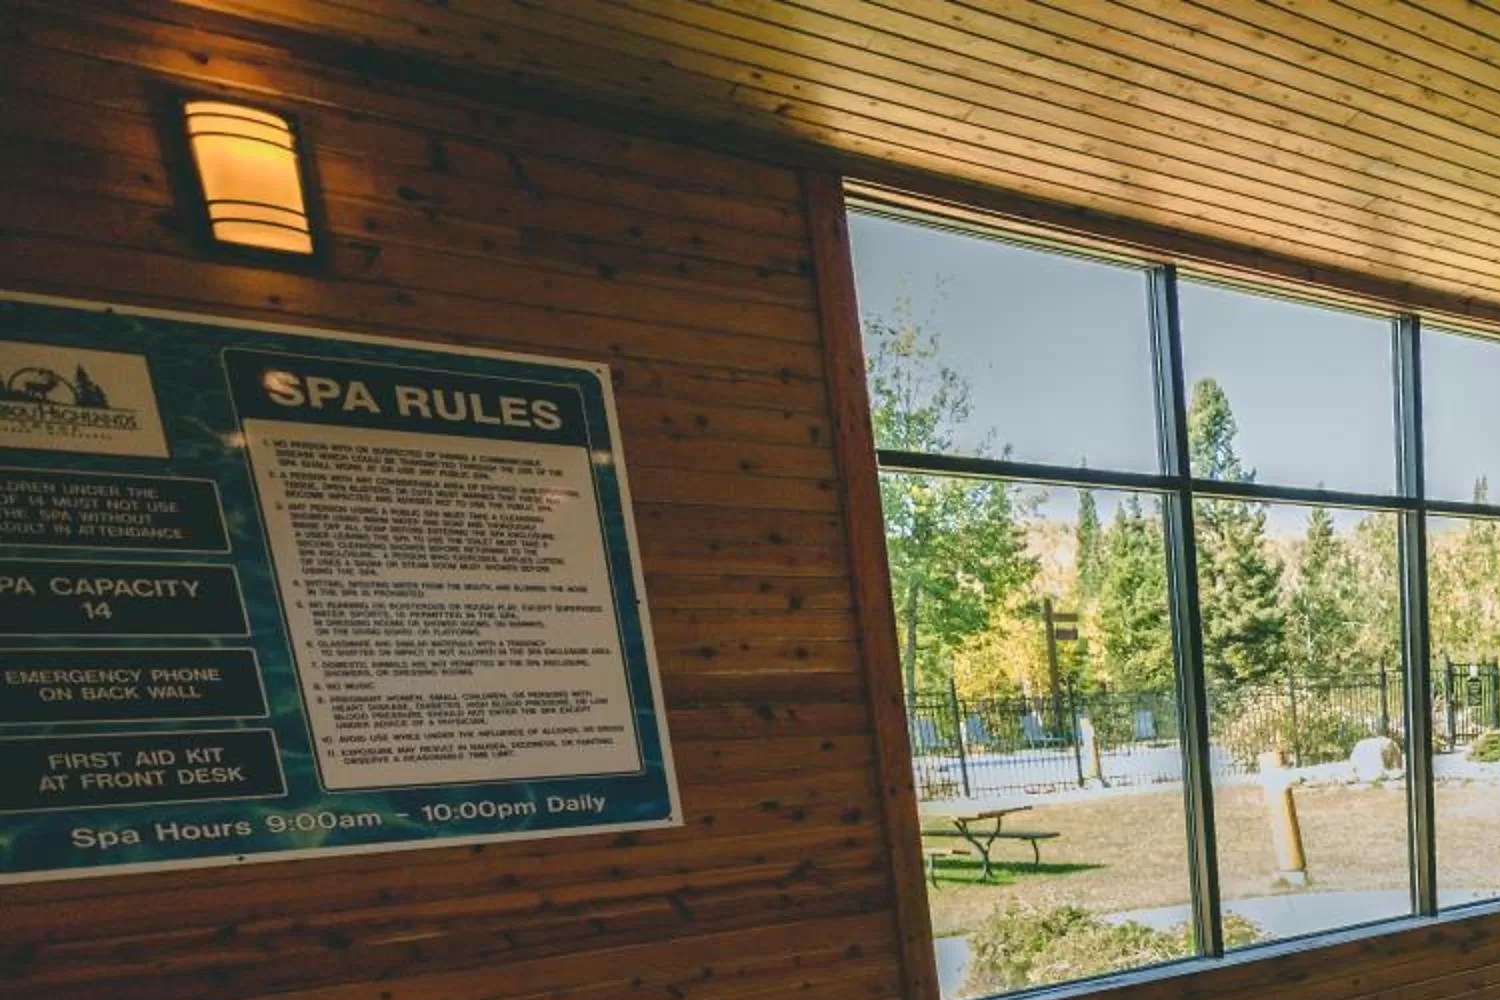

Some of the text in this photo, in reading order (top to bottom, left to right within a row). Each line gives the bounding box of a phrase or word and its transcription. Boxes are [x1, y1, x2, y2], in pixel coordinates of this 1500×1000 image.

[261, 371, 563, 430] SPA RULES
[62, 482, 119, 496] UNDER
[127, 486, 159, 499] THE
[51, 496, 99, 509] MUST
[106, 498, 138, 511] NOT
[147, 501, 180, 513] USE
[78, 510, 152, 524] WITHOUT
[79, 525, 183, 539] ATTENDANCE
[49, 576, 200, 598] CAPACITY
[81, 600, 112, 620] 14
[5, 668, 222, 685] EMERGENCY PHONE
[39, 685, 201, 701] ON BACK WALL
[48, 747, 224, 770] FIRST AID KIT
[39, 766, 247, 792] AT FRONT DESK
[71, 827, 141, 850] Spa
[154, 819, 252, 842] Hours
[265, 809, 382, 832] 9:00am
[422, 797, 537, 821] 10:00pm
[547, 793, 605, 813] Daily
